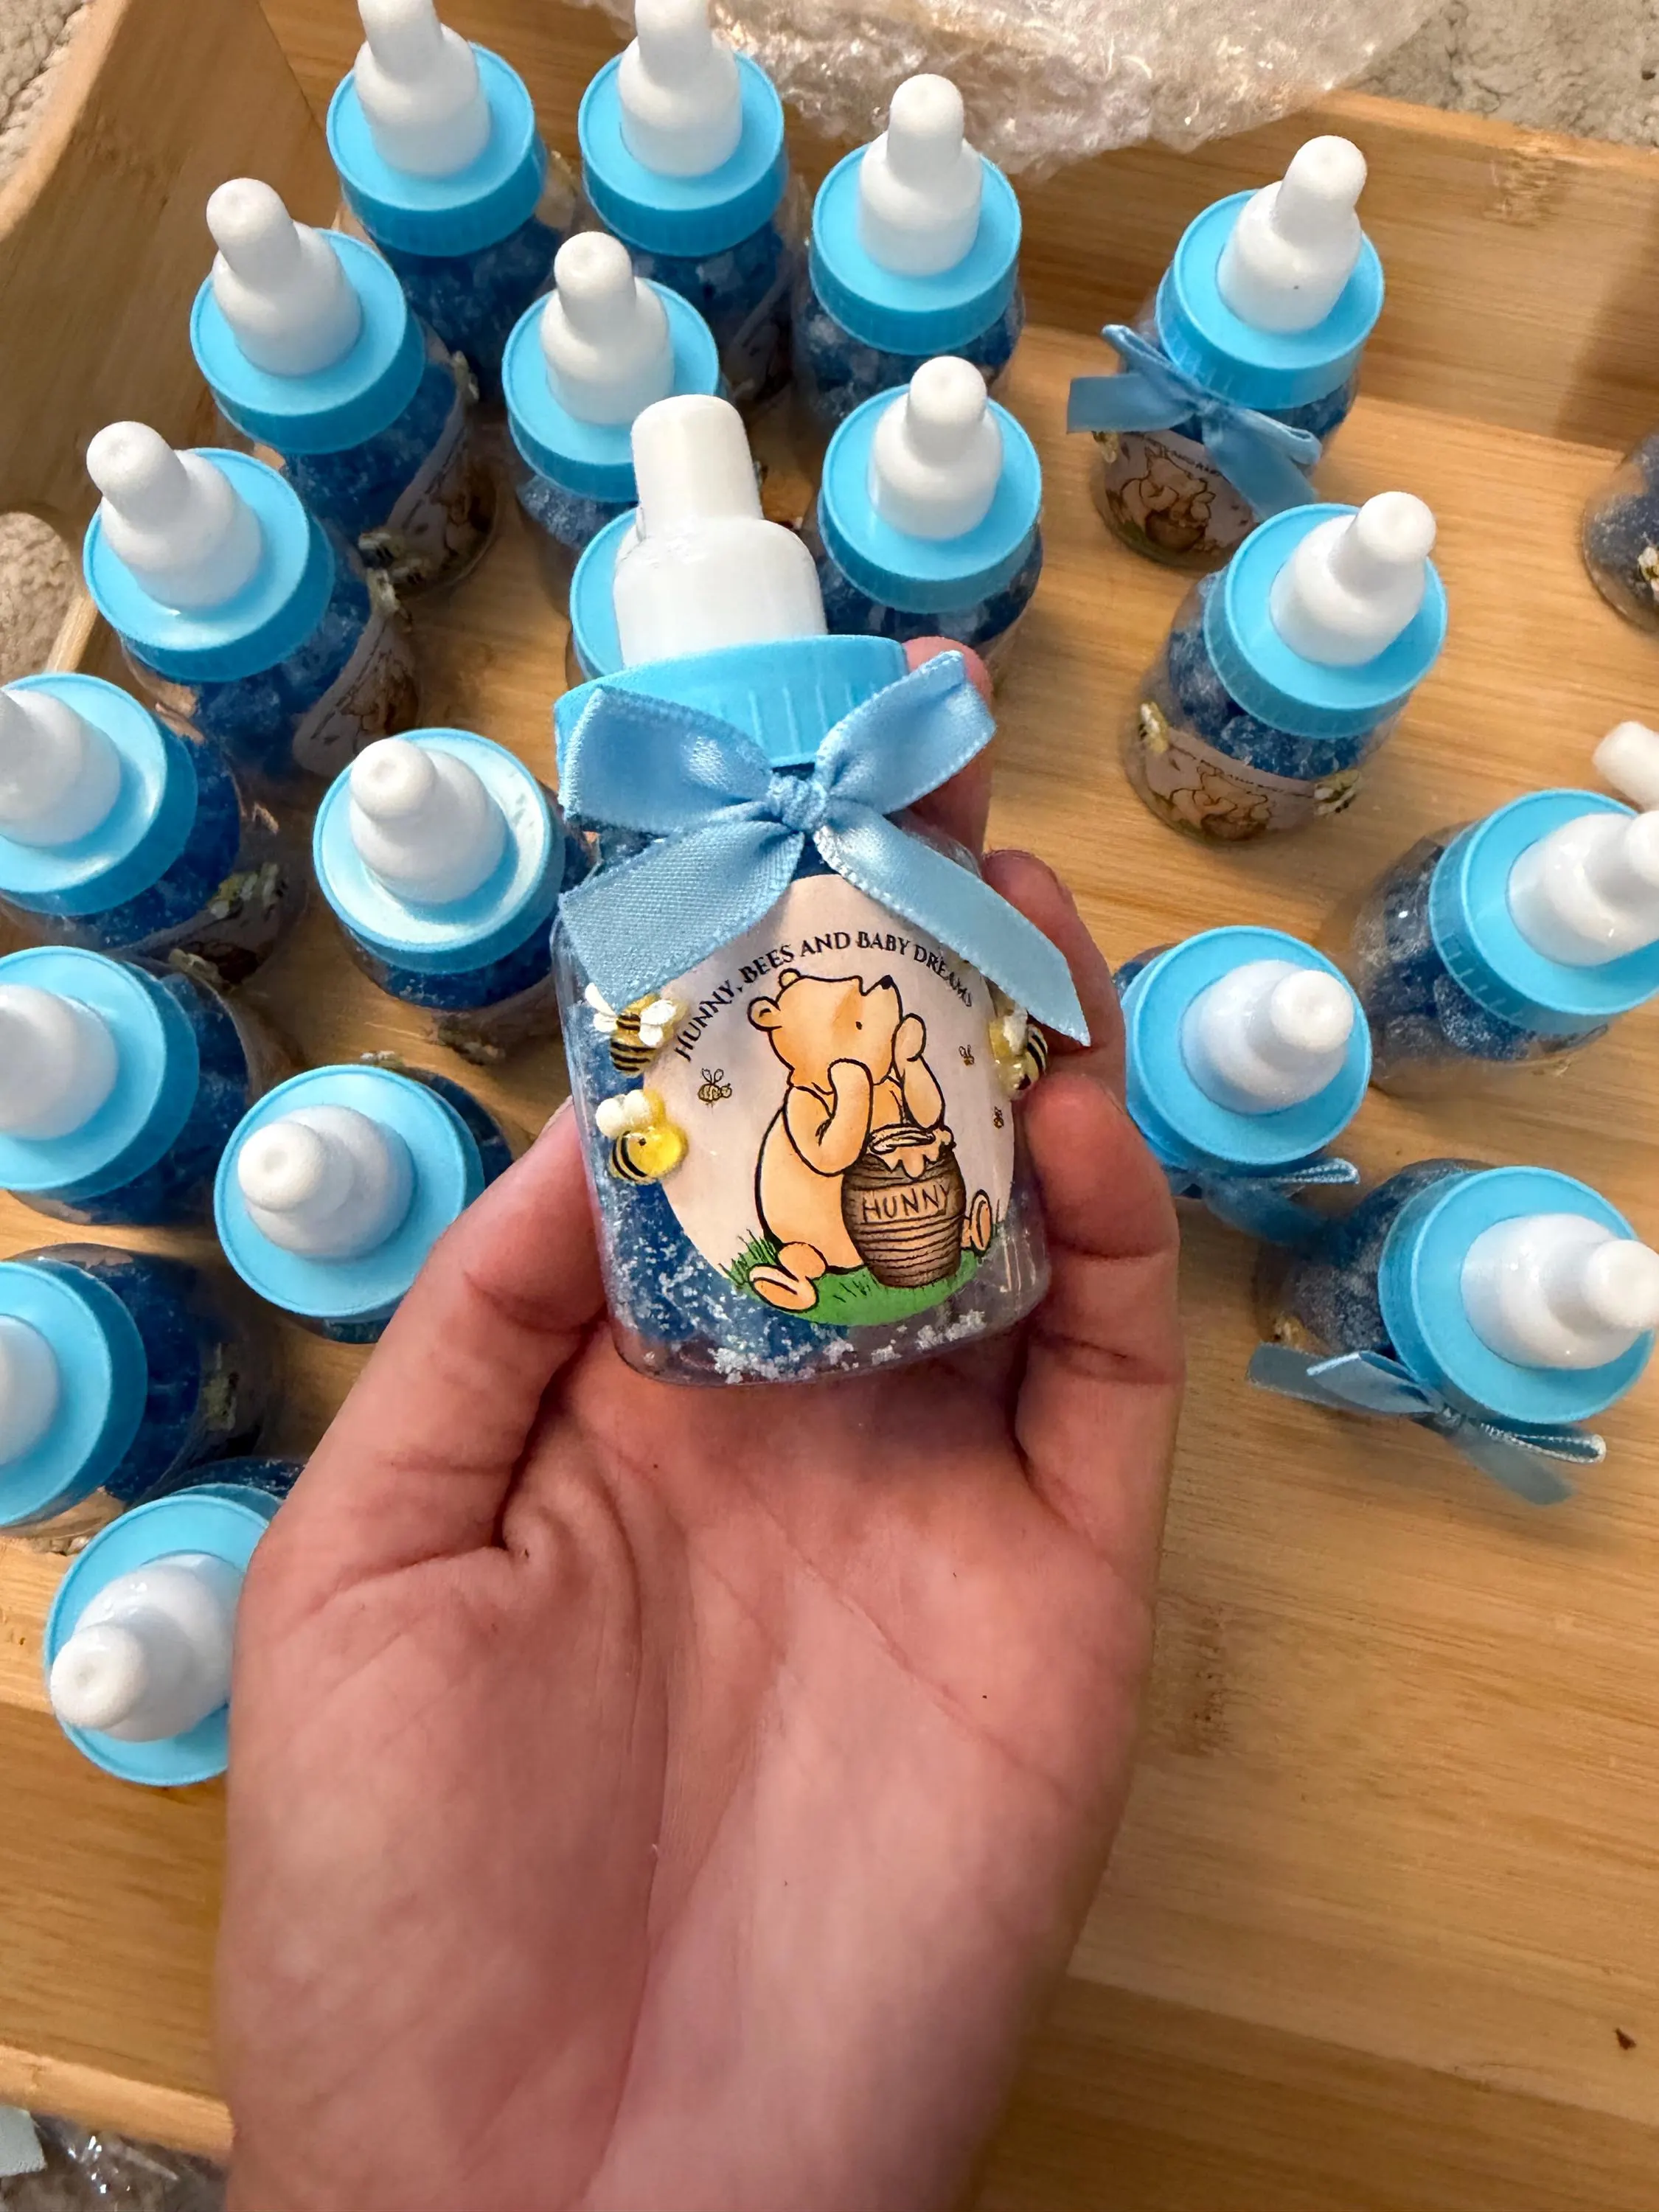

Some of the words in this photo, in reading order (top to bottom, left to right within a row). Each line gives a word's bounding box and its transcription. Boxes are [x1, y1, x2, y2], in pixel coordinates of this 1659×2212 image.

[674, 979, 743, 1062] HUNNY,
[738, 944, 795, 984] BEES
[800, 931, 851, 957] AND
[857, 931, 911, 956] BABY
[862, 1184, 950, 1223] HUNNY
